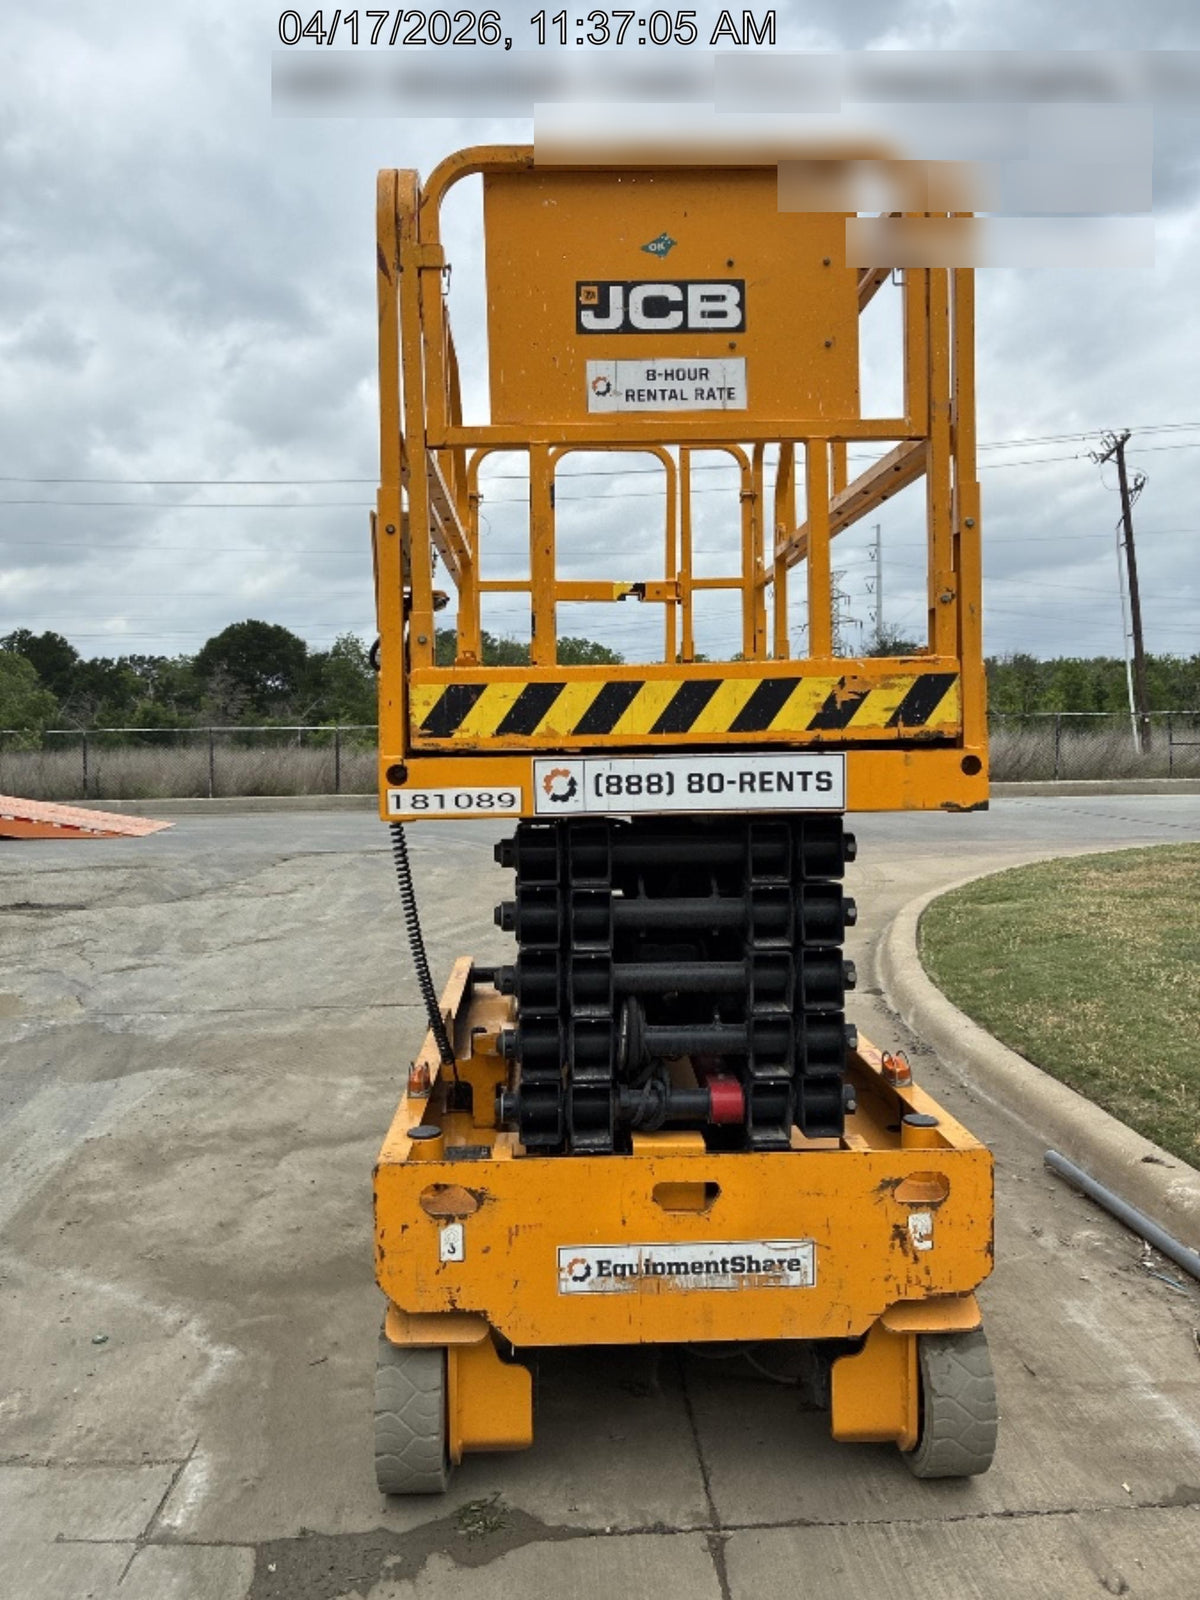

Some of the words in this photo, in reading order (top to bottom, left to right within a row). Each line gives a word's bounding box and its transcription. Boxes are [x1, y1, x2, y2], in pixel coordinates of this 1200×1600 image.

[580, 284, 742, 329] JCB
[625, 388, 688, 402] RENTAL
[694, 387, 736, 400] RATE
[594, 773, 675, 796] (888)
[687, 770, 833, 794] 80-RENTS
[391, 792, 516, 810] 181089
[597, 1256, 801, 1279] EquipmentShare
